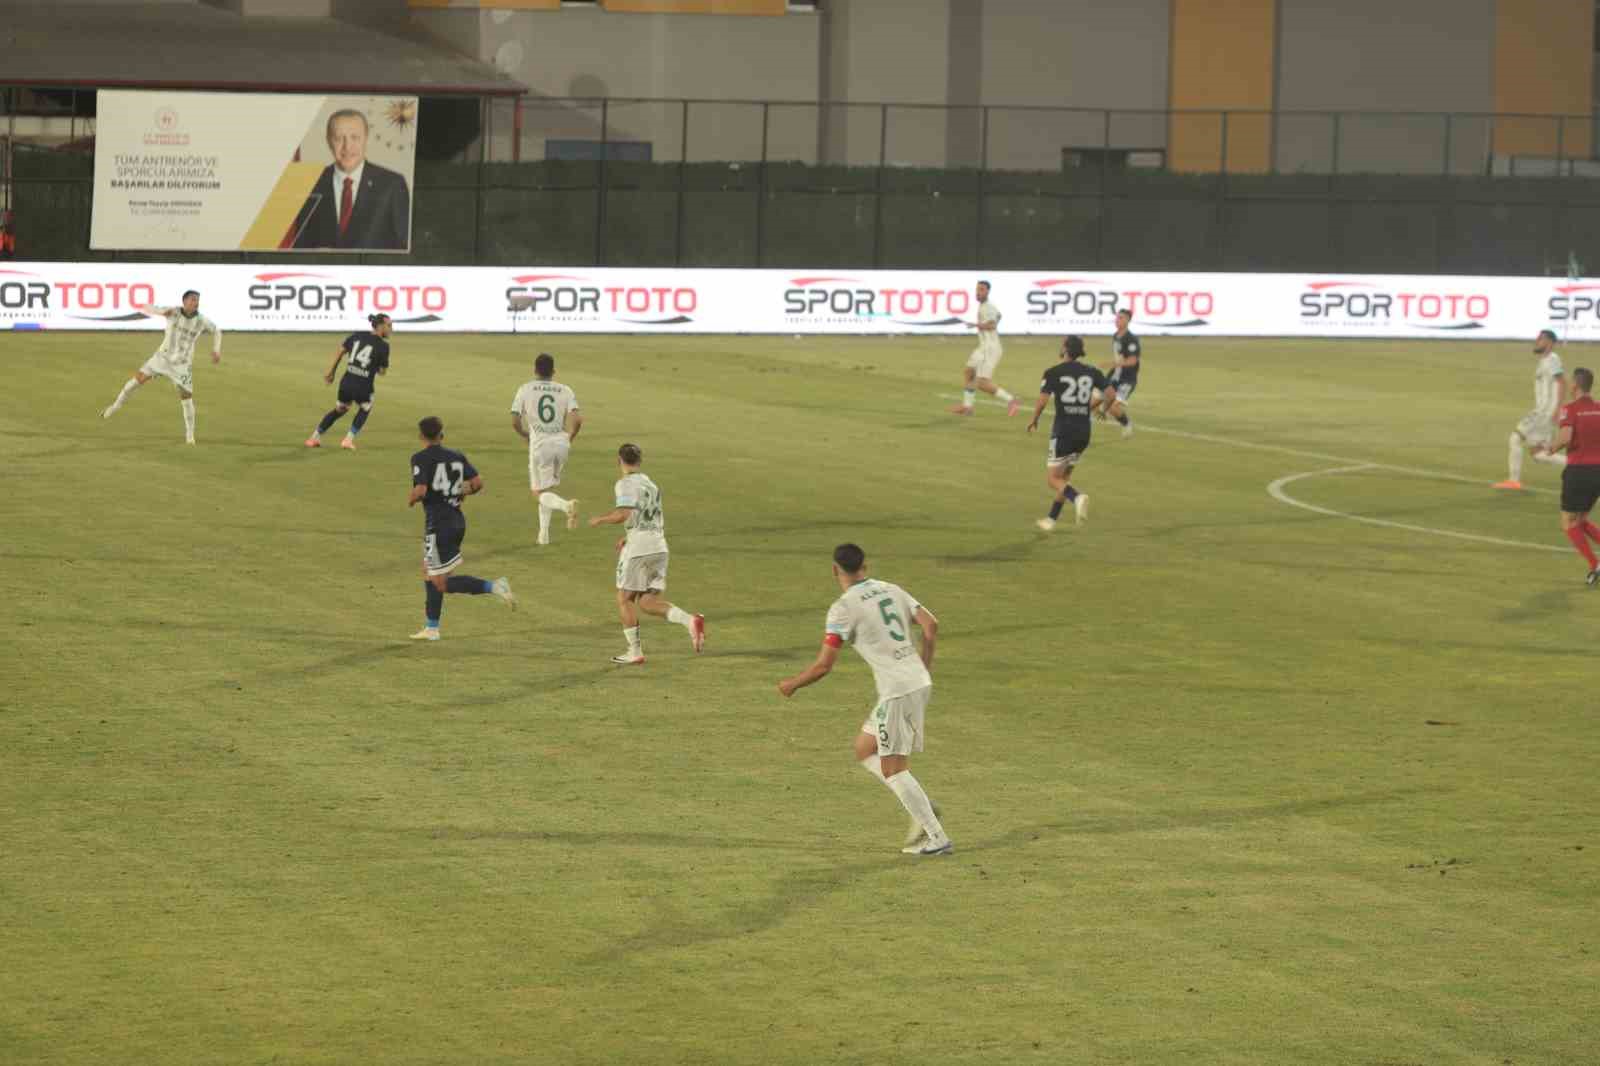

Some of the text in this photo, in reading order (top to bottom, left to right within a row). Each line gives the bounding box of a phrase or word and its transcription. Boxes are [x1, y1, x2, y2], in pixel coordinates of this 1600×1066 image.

[110, 179, 165, 190] BAŞARILAR
[0, 283, 50, 308] OR
[1549, 297, 1600, 320] SP
[349, 340, 373, 368] 14
[1059, 375, 1093, 404] 28
[538, 394, 556, 424] 6
[432, 461, 465, 497] 42
[878, 597, 905, 642] 5
[879, 723, 889, 742] 5
